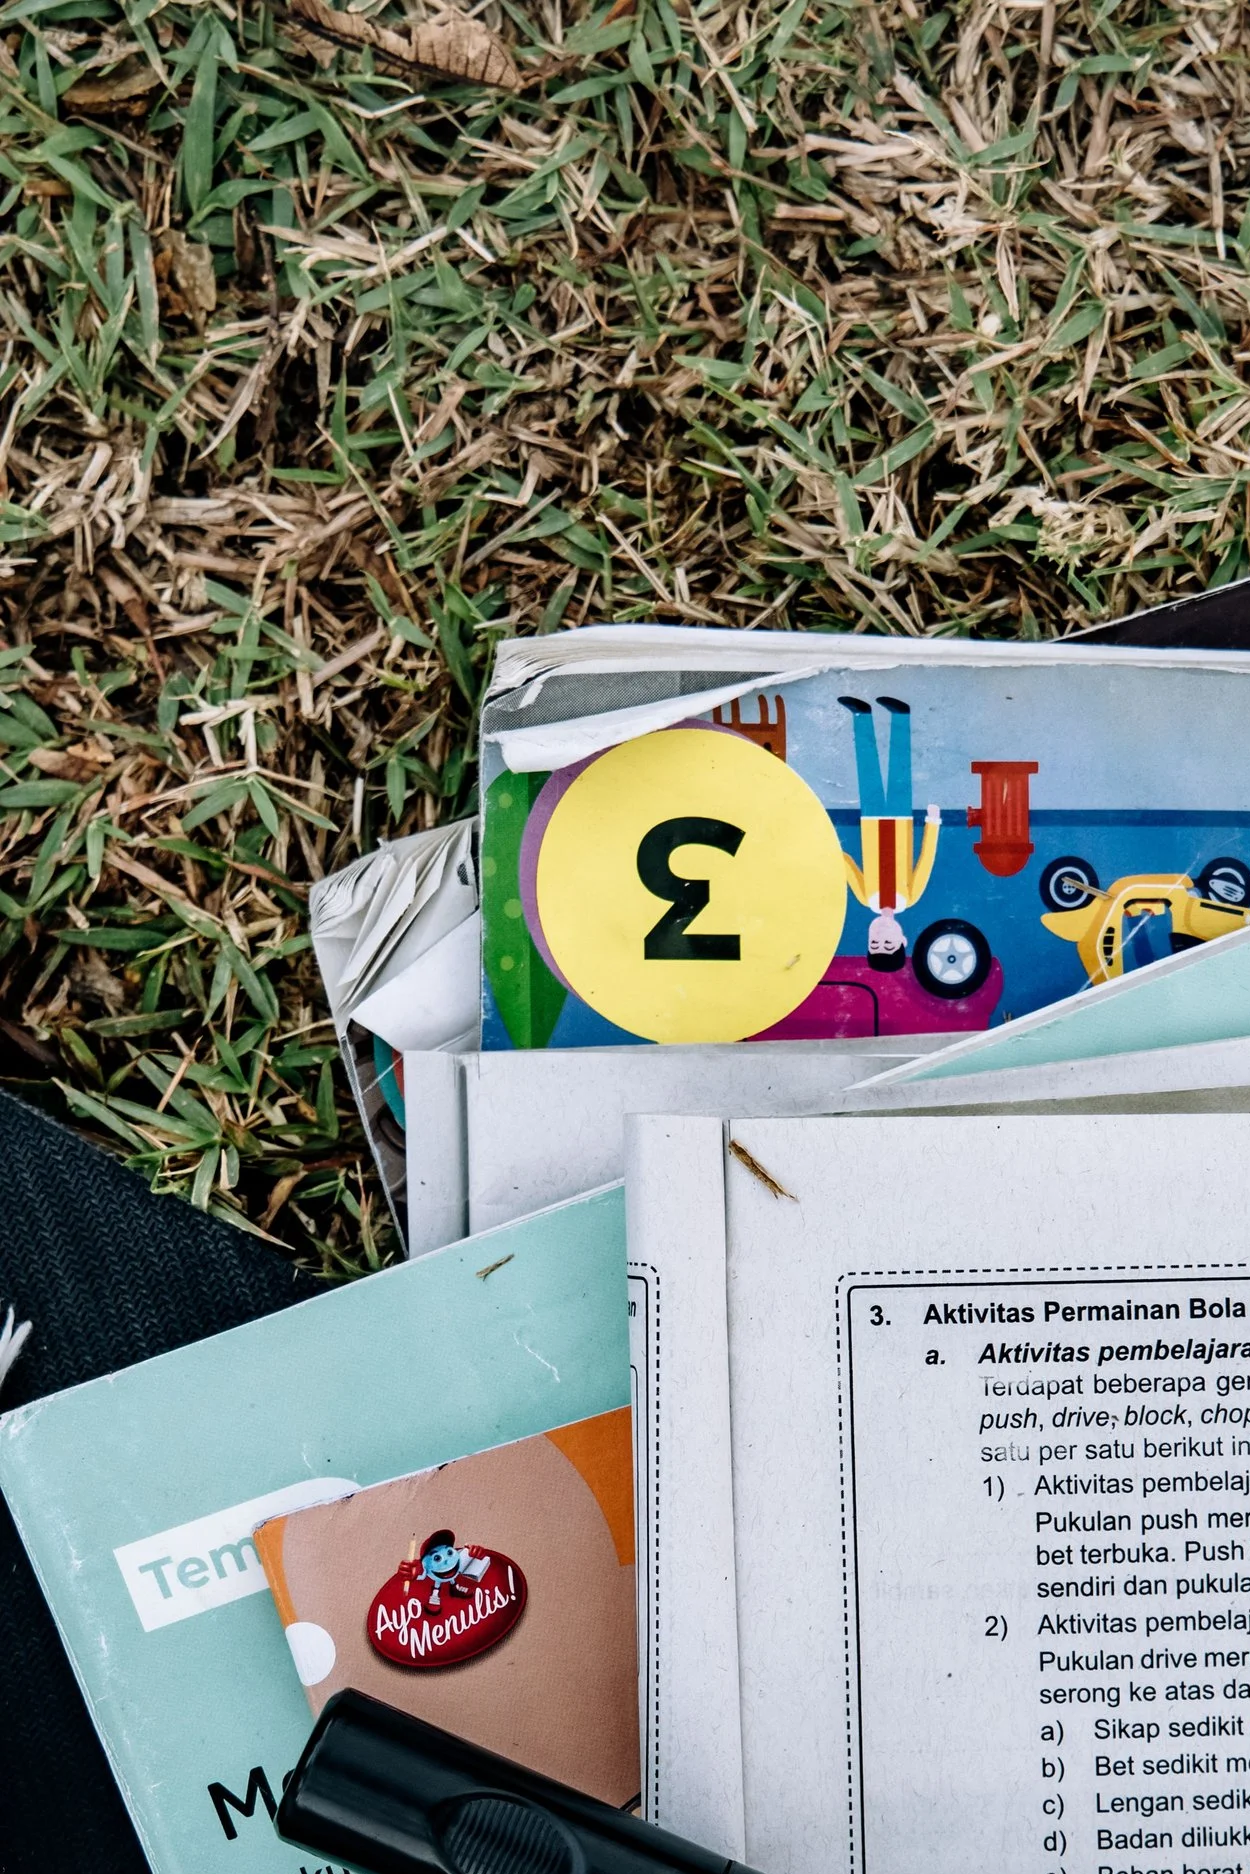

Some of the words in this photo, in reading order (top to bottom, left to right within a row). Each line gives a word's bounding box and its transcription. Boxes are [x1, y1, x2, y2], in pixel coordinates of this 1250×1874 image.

[869, 1304, 892, 1327] 3.
[922, 1302, 1036, 1325] Aktivitas
[1043, 1299, 1180, 1323] Permainan
[1189, 1296, 1247, 1320] Bola
[924, 1348, 946, 1366] a.
[977, 1341, 1091, 1365] Aktivitas
[980, 1442, 1030, 1463] satu
[1039, 1444, 1078, 1467] per
[1084, 1439, 1135, 1460] satu
[1143, 1436, 1225, 1459] berikut
[138, 1536, 262, 1599] Tem
[1036, 1575, 1115, 1599] sendiri
[1123, 1574, 1168, 1597] dan
[375, 1597, 422, 1646] Ayo
[410, 1565, 517, 1659] Menulis!
[984, 1614, 1009, 1643] 2)
[1036, 1612, 1138, 1636] Aktivitas
[1040, 1719, 1065, 1747] a)
[1093, 1718, 1161, 1744] Sikap
[1168, 1715, 1245, 1738] sedikit
[1041, 1756, 1065, 1784] b)
[1095, 1755, 1136, 1777] Bet
[1142, 1753, 1219, 1776] sedikit
[1042, 1792, 1065, 1821] c)
[1095, 1792, 1184, 1818] Lengan
[1043, 1829, 1068, 1857] d)
[1096, 1828, 1173, 1851] Badan
